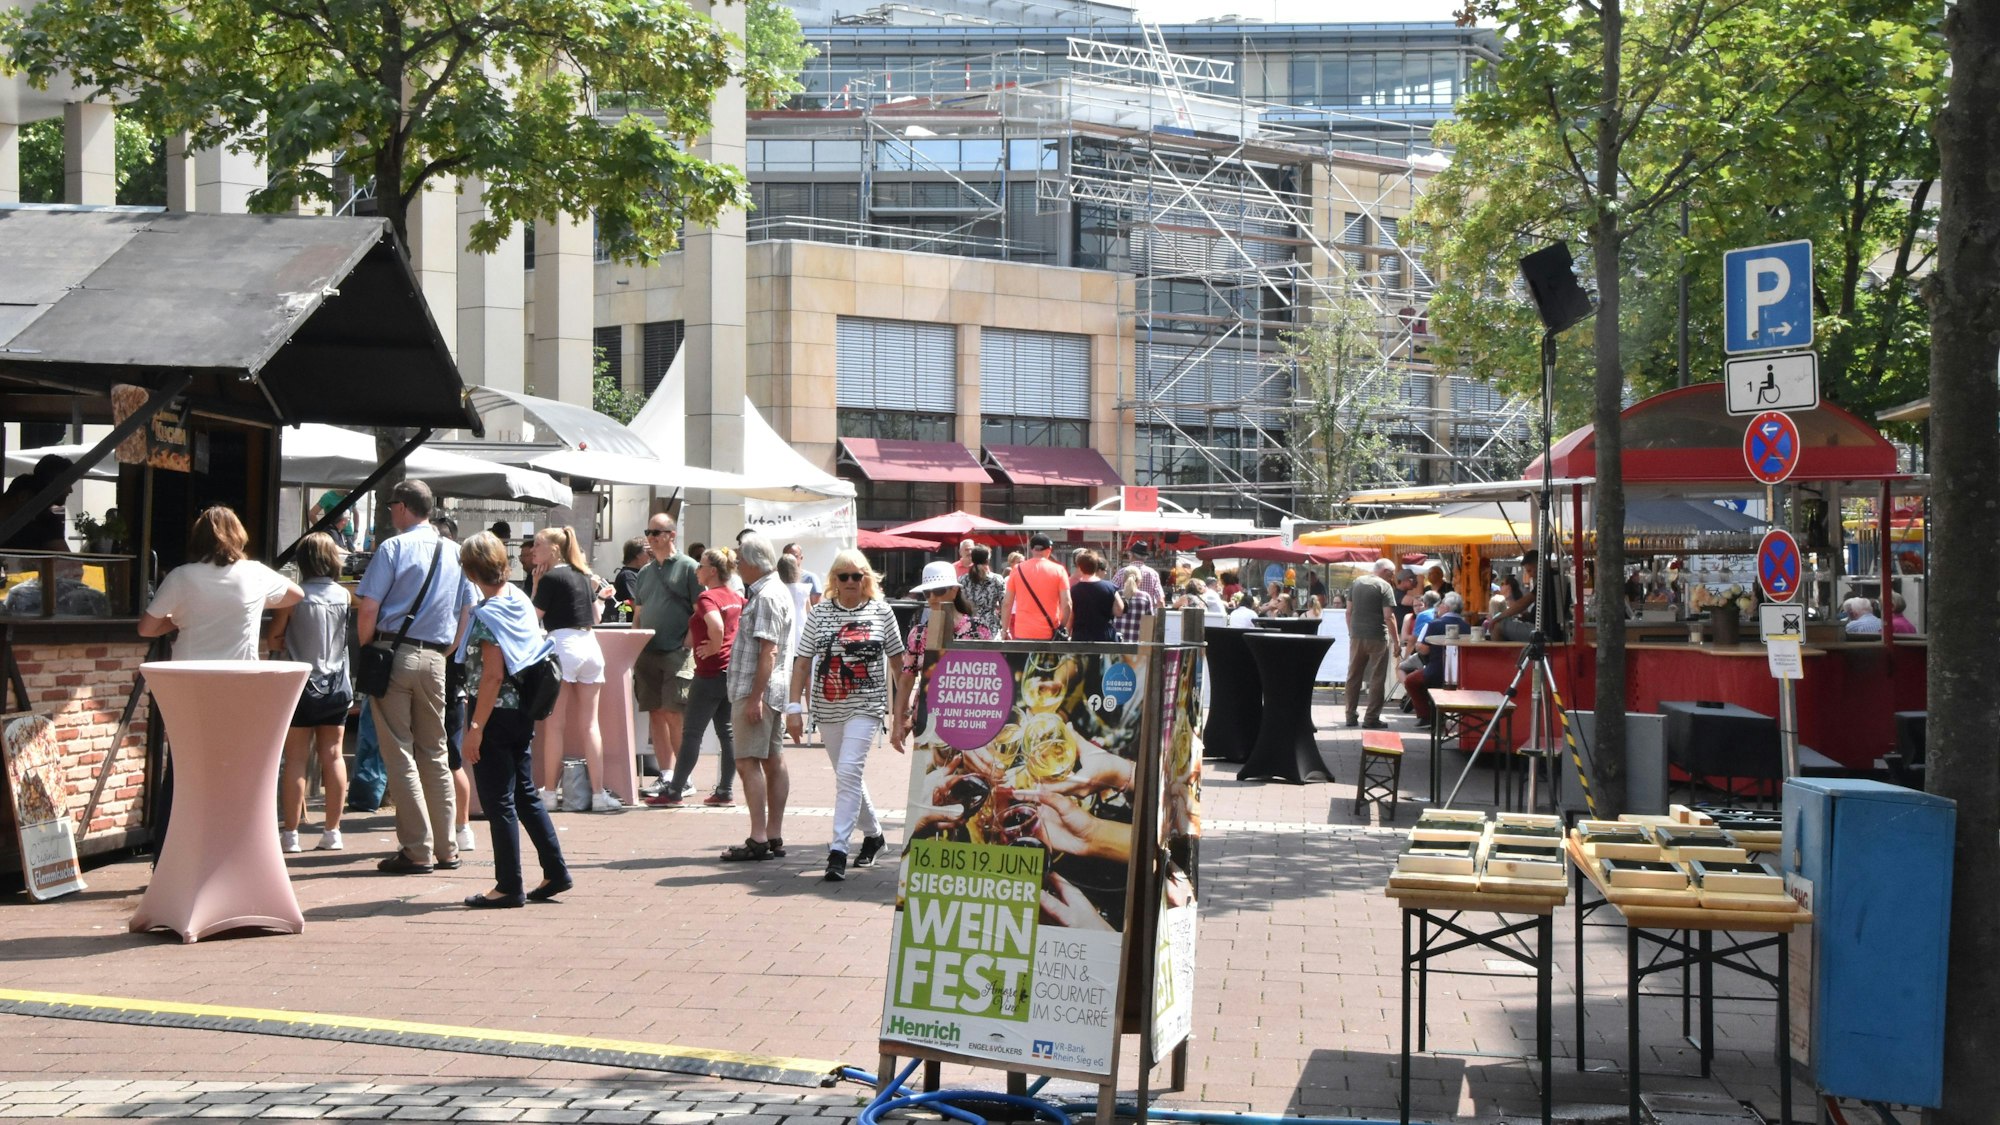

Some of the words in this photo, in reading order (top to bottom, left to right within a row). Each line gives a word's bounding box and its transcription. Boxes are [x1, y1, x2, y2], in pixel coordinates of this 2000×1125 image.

[1745, 257, 1791, 340] P
[1746, 381, 1753, 392] 1
[946, 661, 997, 676] LANGER
[938, 675, 1002, 691] SIEGBURG
[938, 690, 1000, 706] SAMSTAG
[943, 708, 962, 717] JUNI
[964, 709, 1002, 719] SHOPPEN
[943, 719, 956, 728] BIS
[958, 720, 968, 729] 20
[970, 721, 987, 729] UHR
[914, 846, 935, 868] 16.
[940, 850, 966, 870] BIS
[972, 851, 992, 873] 19.
[996, 853, 1039, 876] JUNI
[910, 872, 1036, 903] SIEGBURGER
[909, 897, 1034, 955] WEIN
[1039, 941, 1047, 956] 4
[1053, 941, 1087, 960] TAGE
[899, 947, 1029, 1016] FEST
[1038, 961, 1077, 980] WEIN
[1080, 965, 1089, 982] &
[1035, 982, 1106, 1005] GOURMET
[1033, 1003, 1049, 1020] IM
[1053, 1005, 1108, 1028] S-CARRÉ
[890, 1015, 960, 1041] Henrich
[1054, 1042, 1086, 1054] VR-Bank
[1053, 1053, 1092, 1067] Rhein-Sieg
[1093, 1057, 1104, 1067] eG
